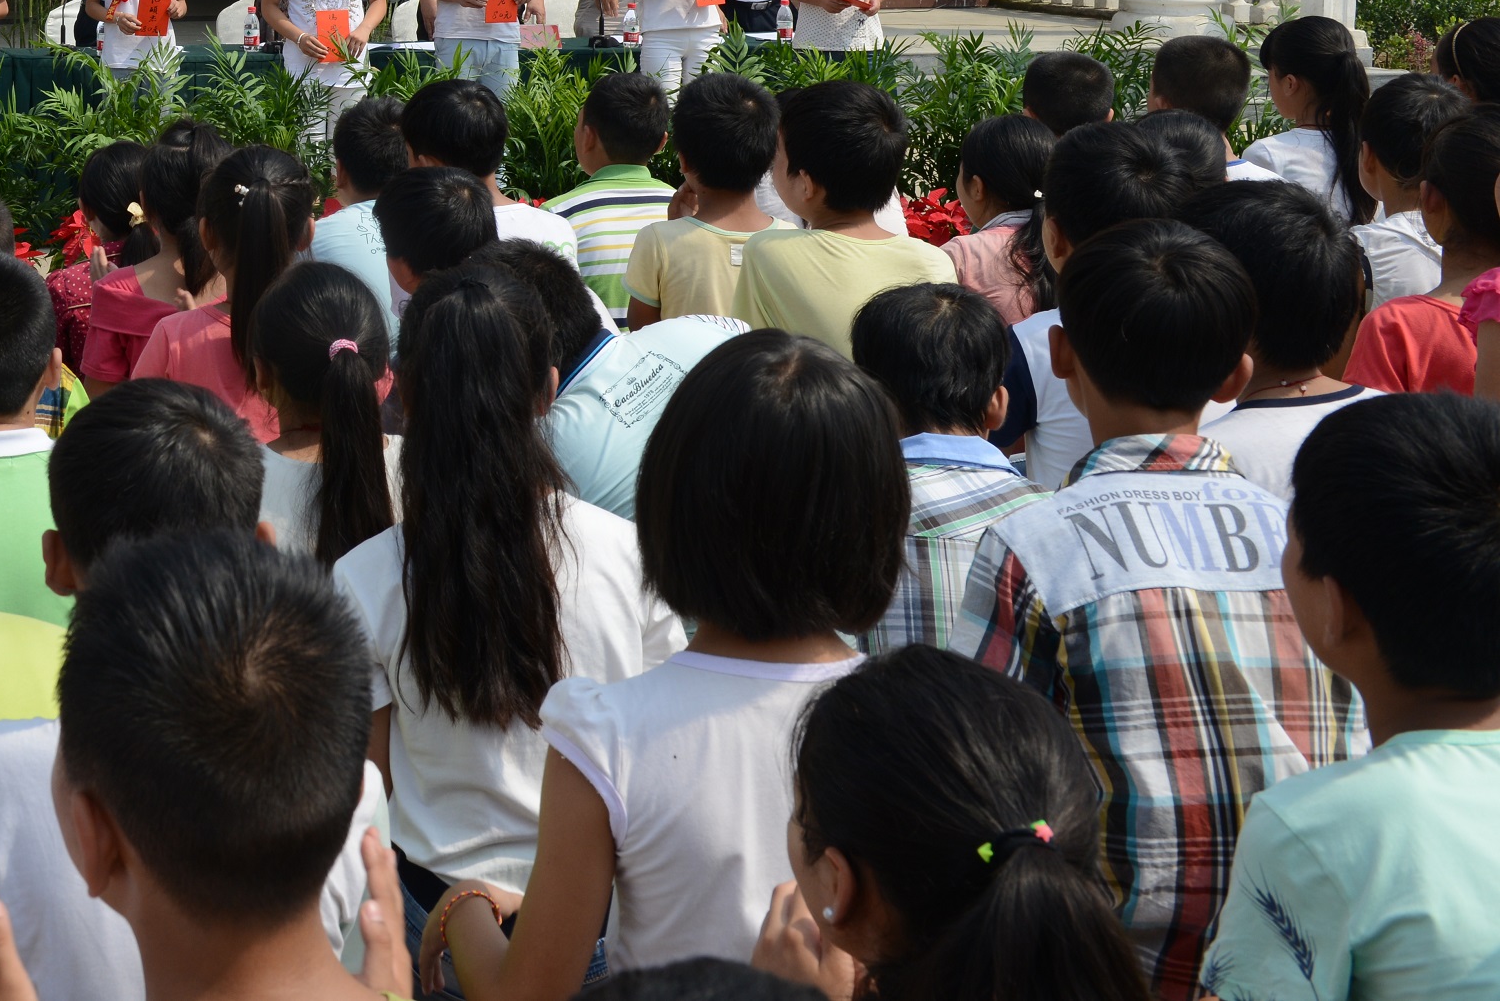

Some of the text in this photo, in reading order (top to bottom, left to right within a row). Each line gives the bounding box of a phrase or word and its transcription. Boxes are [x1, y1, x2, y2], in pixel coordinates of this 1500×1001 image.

[1057, 490, 1121, 515] FASHION
[1122, 489, 1171, 500] DRESS
[1173, 490, 1202, 501] BOY
[1064, 501, 1288, 580] NUMBE
